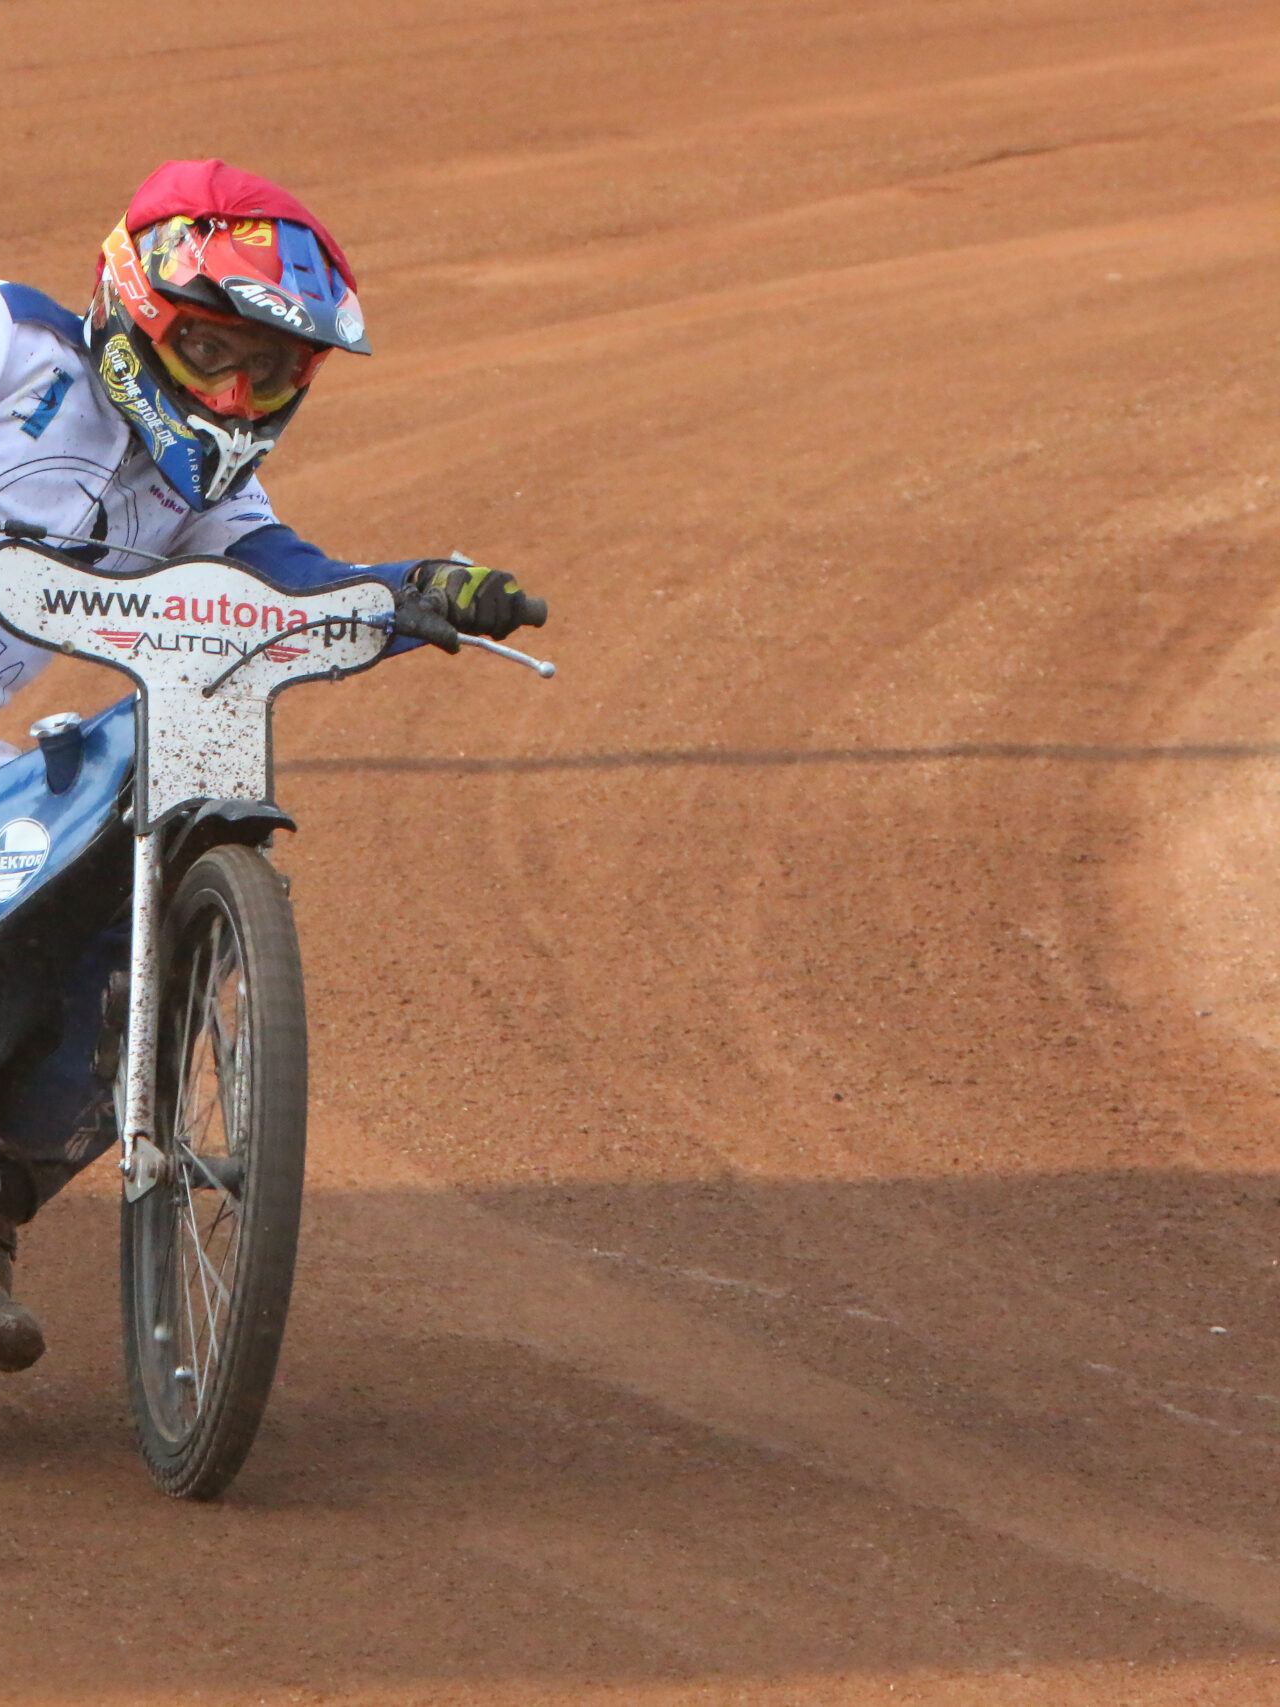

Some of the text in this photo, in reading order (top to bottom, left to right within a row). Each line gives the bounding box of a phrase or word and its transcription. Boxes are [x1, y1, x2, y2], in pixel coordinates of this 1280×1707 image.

[229, 284, 303, 327] Airoh
[187, 448, 201, 493] AIROH
[43, 588, 359, 648] www.autona.pl
